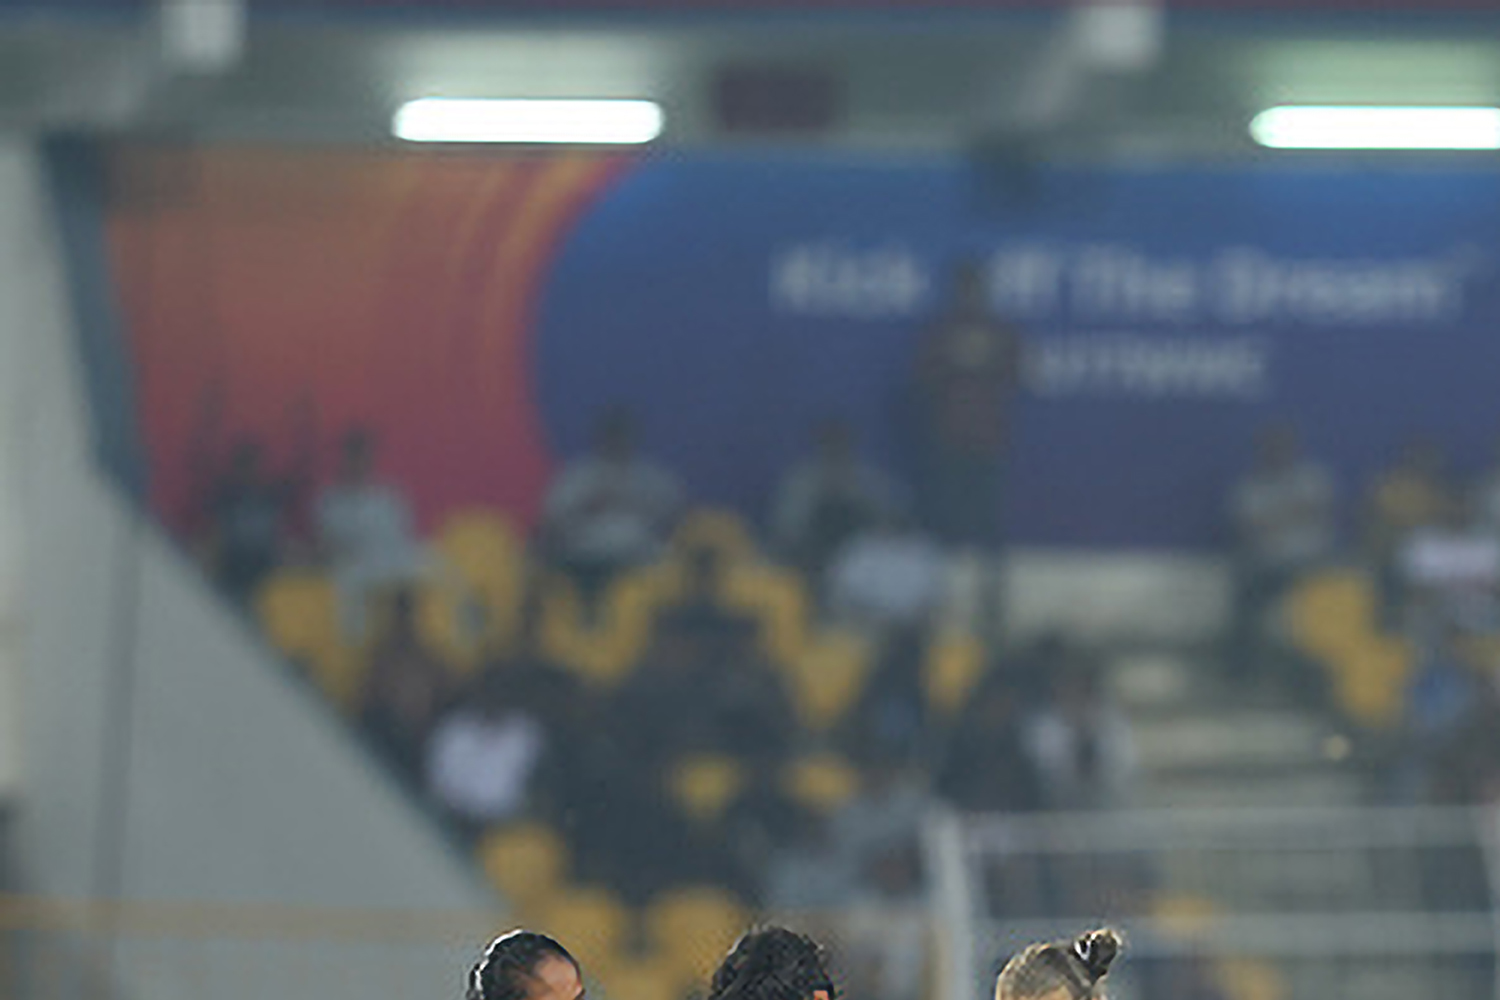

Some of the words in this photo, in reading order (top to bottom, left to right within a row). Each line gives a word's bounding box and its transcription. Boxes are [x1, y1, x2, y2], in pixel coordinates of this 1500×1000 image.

[772, 243, 926, 313] Kick
[1070, 246, 1198, 316] The
[1213, 250, 1458, 321] Dream
